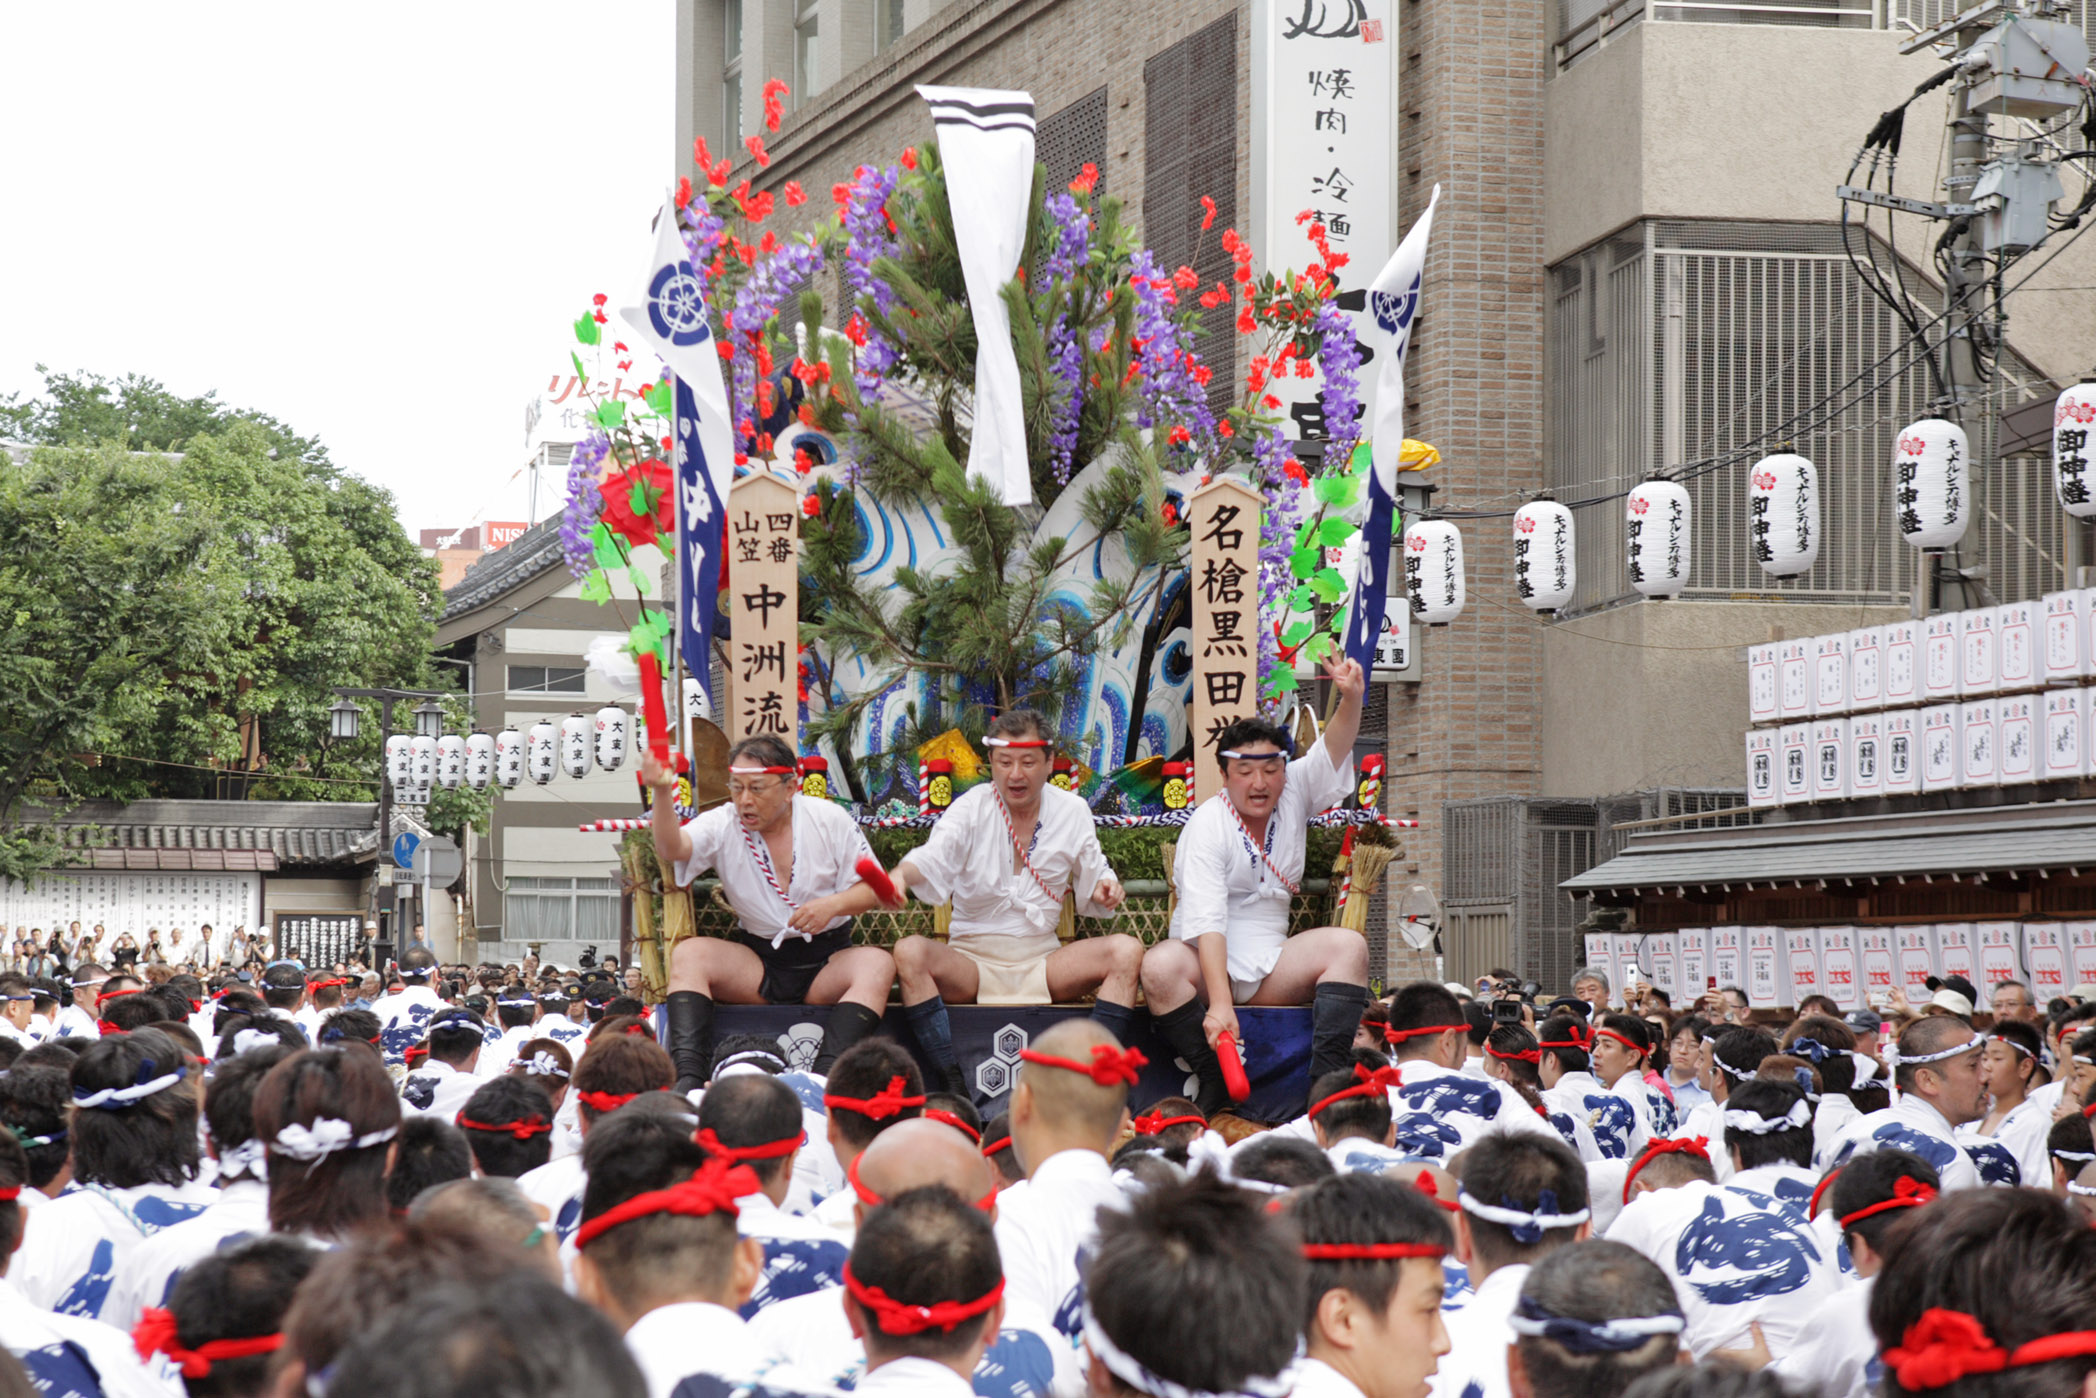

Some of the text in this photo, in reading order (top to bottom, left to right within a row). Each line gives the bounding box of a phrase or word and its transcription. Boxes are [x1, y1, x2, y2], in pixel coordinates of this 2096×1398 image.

[1795, 465, 1812, 554] キャナルシティ博多
[1944, 439, 1961, 525] キャナルシティ博多
[733, 511, 761, 562] 山笠
[766, 512, 794, 563] 四番
[1444, 534, 1456, 607] キャナルシティ博多
[1554, 514, 1567, 592] キャナルシティ博多
[1666, 499, 1682, 580] キャナルシティ博多
[741, 583, 789, 736] 中洲流
